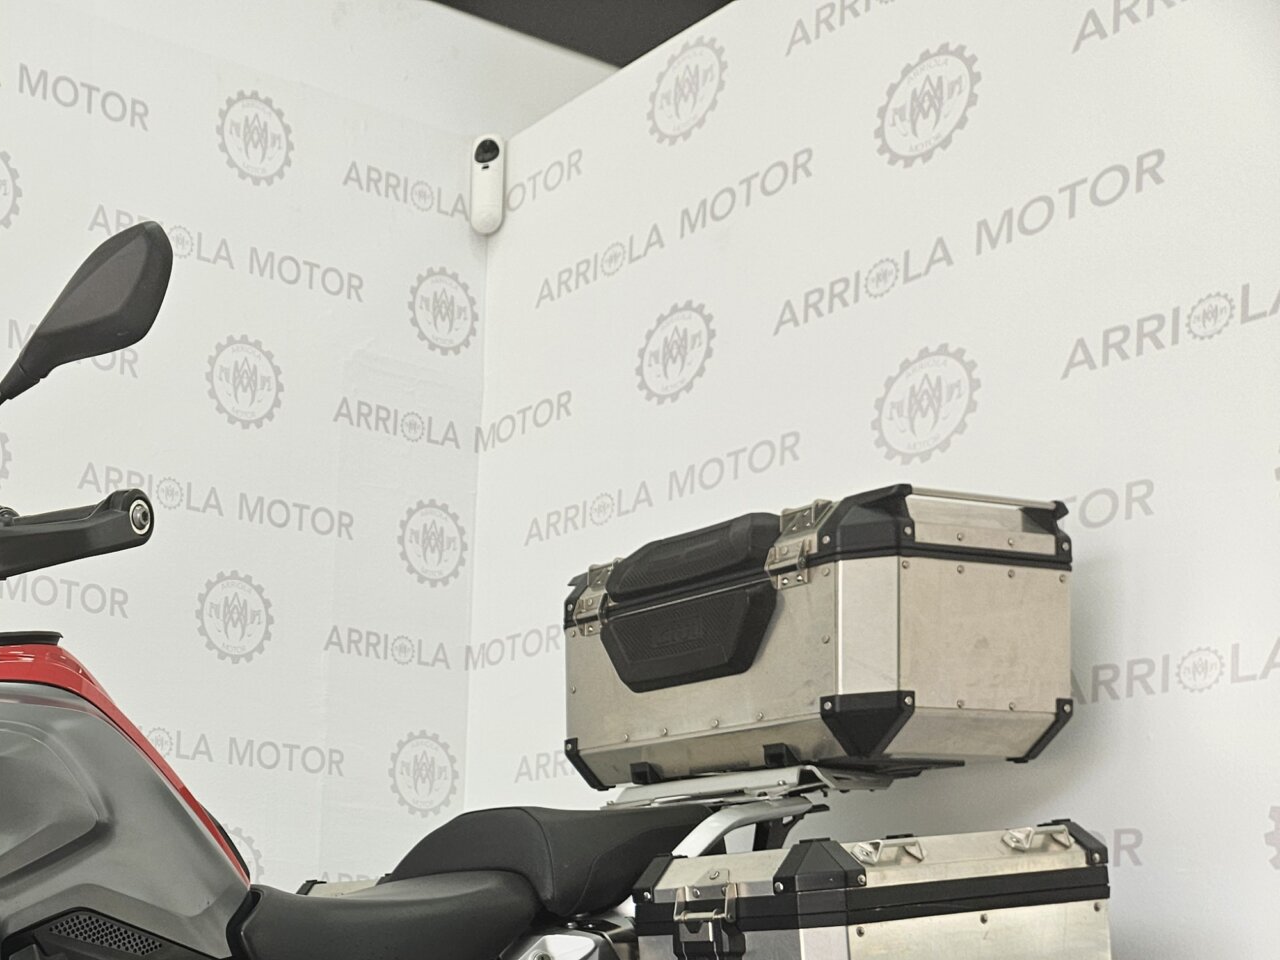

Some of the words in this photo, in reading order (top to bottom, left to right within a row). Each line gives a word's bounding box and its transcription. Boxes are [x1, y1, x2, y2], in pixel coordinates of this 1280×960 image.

[18, 63, 150, 132] MOTOR
[506, 149, 583, 212] OTOR
[679, 148, 814, 240] MOTOR
[975, 149, 1166, 256] MOTOR
[249, 247, 364, 303] MOTOR
[1060, 283, 1280, 380] ARRIOL
[473, 390, 572, 454] MOTOR
[668, 431, 800, 501] MOTOR
[238, 492, 354, 541] MOTOR
[464, 624, 562, 672] MOTOR
[228, 737, 345, 777] MOTOR
